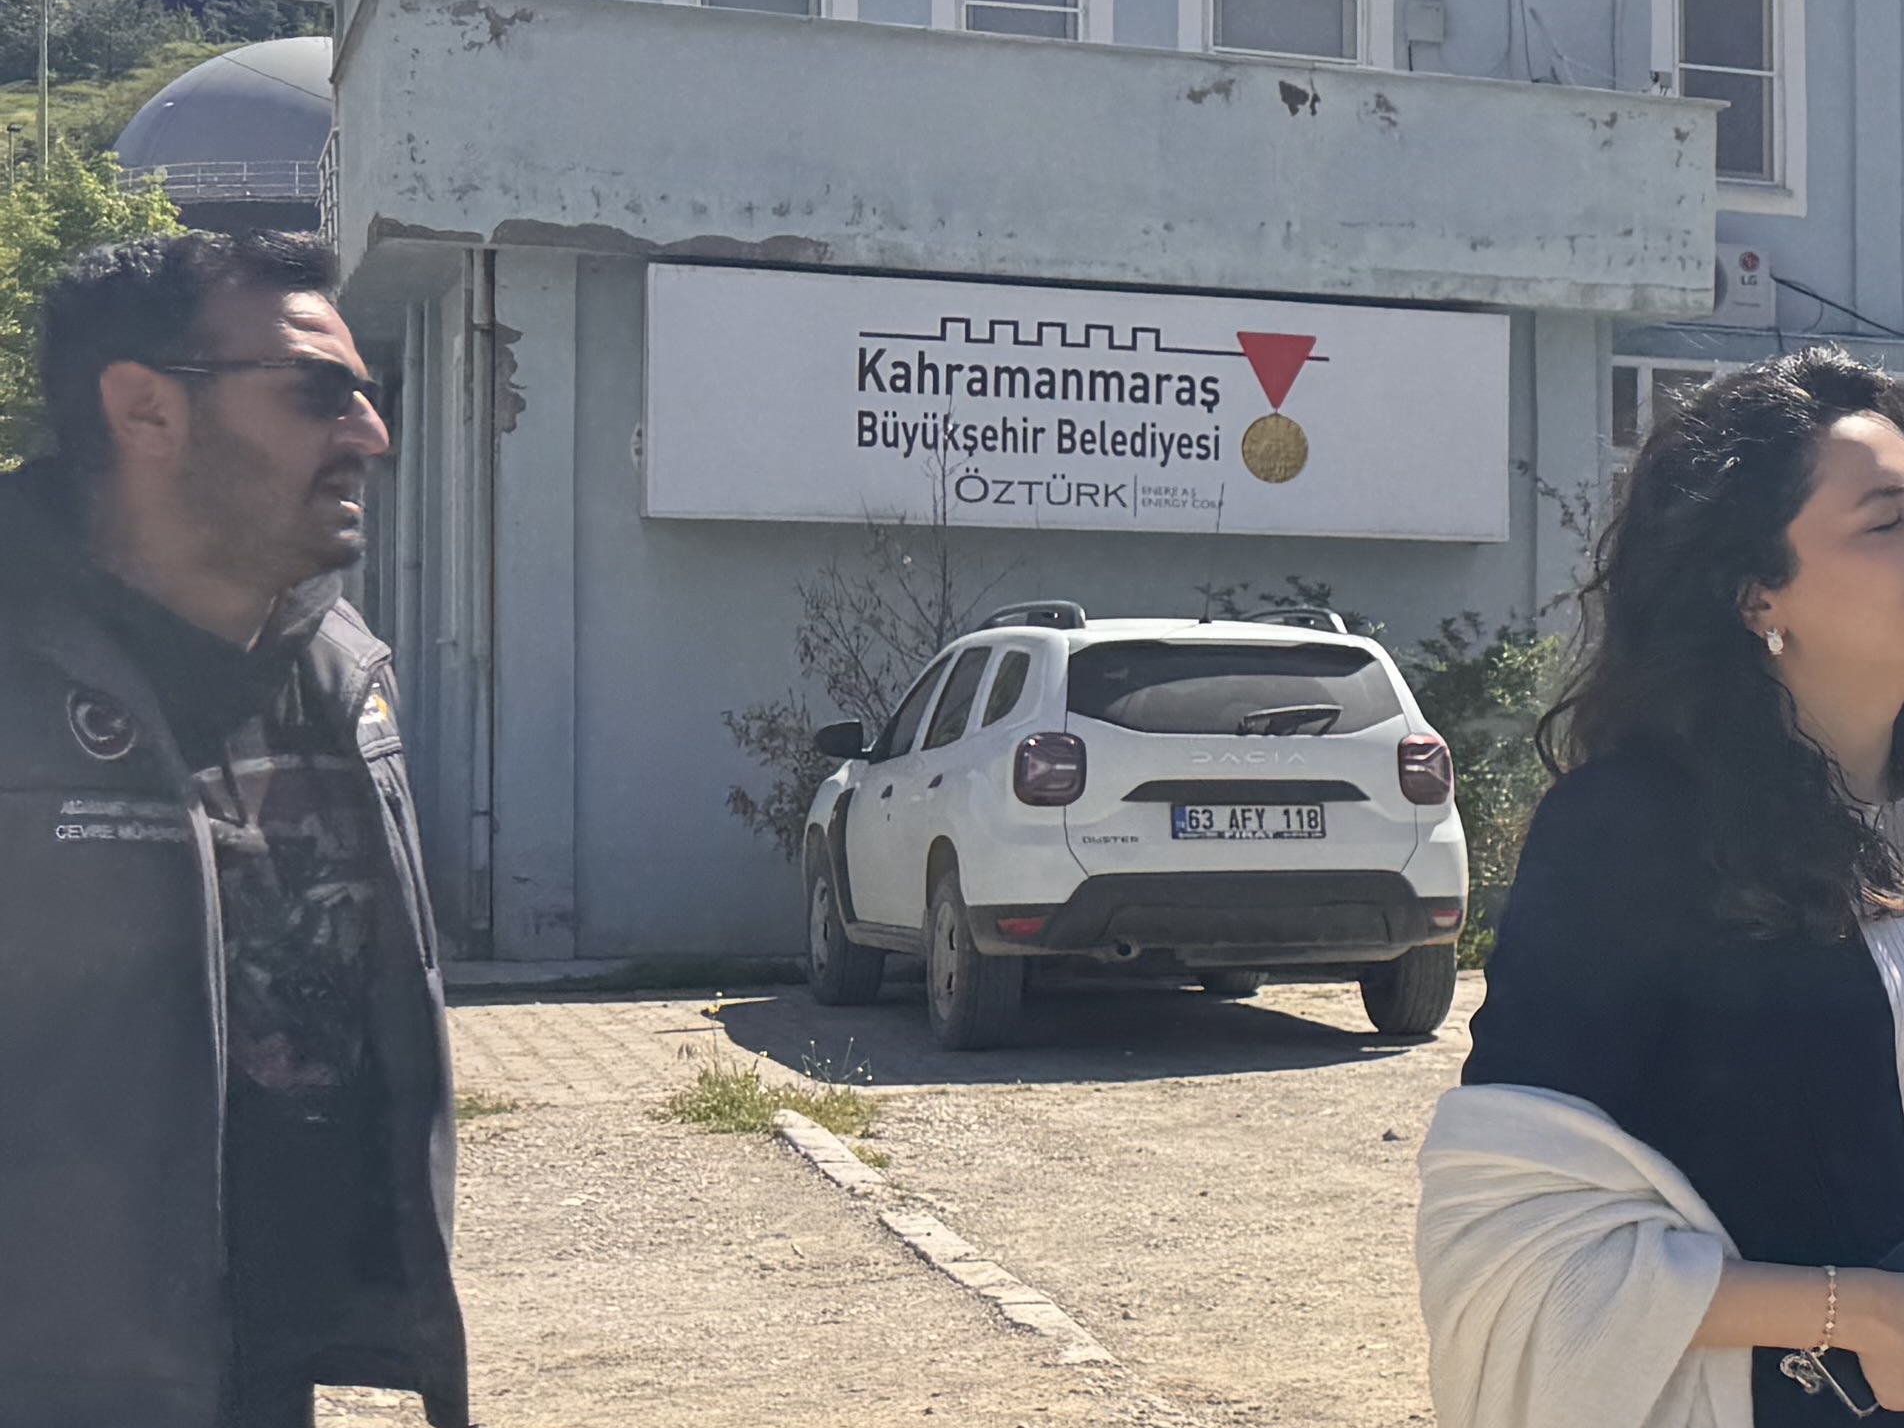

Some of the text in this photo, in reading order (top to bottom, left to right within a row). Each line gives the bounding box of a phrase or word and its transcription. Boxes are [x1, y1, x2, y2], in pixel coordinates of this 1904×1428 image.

[857, 346, 1221, 414] Kahramanmaraş
[856, 409, 1221, 468] Büyükşehir Belediyesi
[954, 466, 1128, 509] ÖZTÜRK
[1192, 751, 1306, 764] DACIA
[1188, 807, 1319, 830] 63 AFY 118
